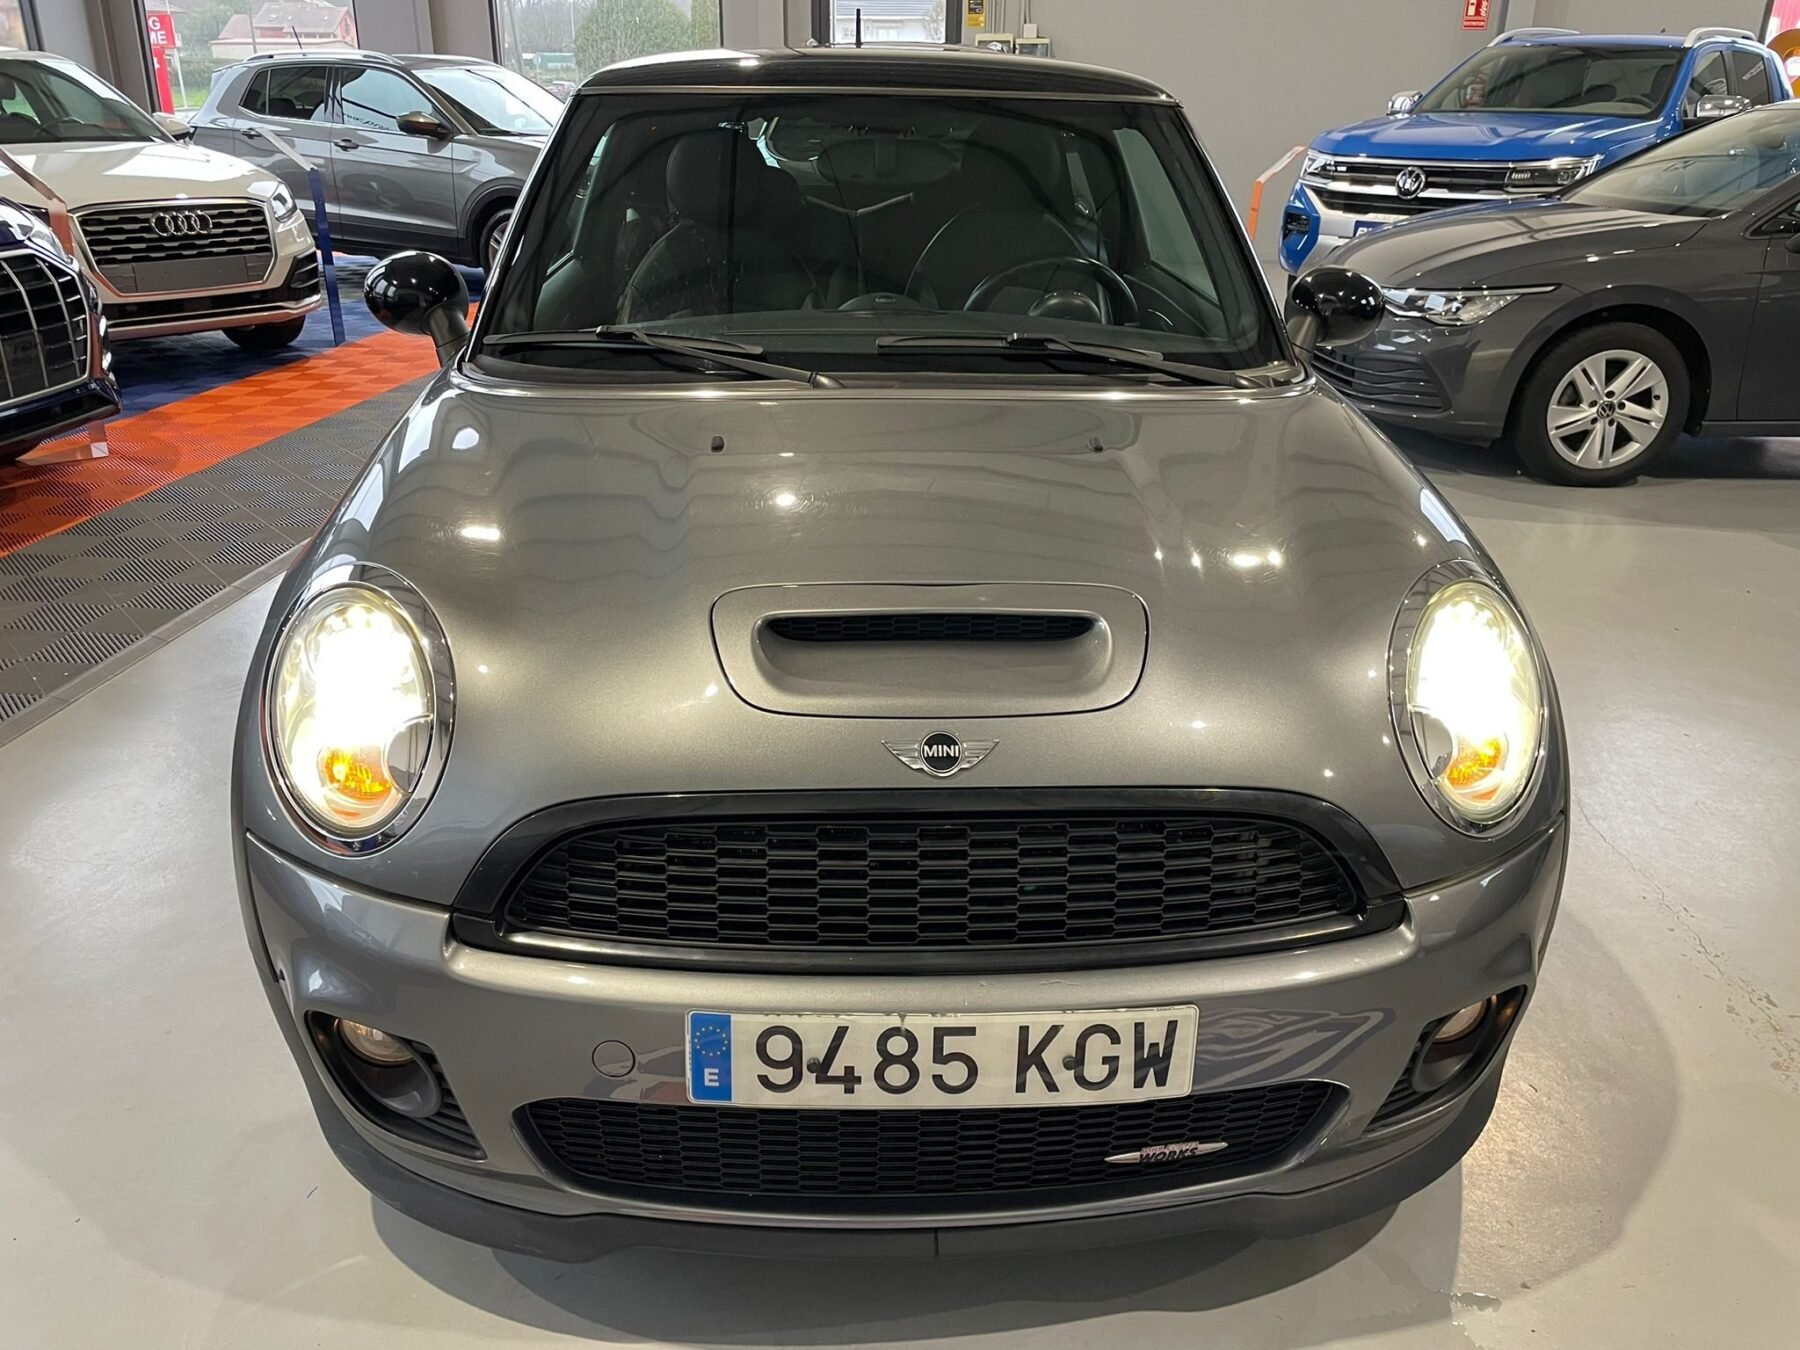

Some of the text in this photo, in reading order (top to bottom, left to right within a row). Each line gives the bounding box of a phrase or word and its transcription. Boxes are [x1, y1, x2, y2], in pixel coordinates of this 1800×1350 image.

[923, 744, 960, 758] MINI
[703, 1067, 720, 1087] E
[755, 1025, 979, 1095] 9485
[1015, 1019, 1179, 1094] KGW
[1140, 1146, 1199, 1162] WORKS
